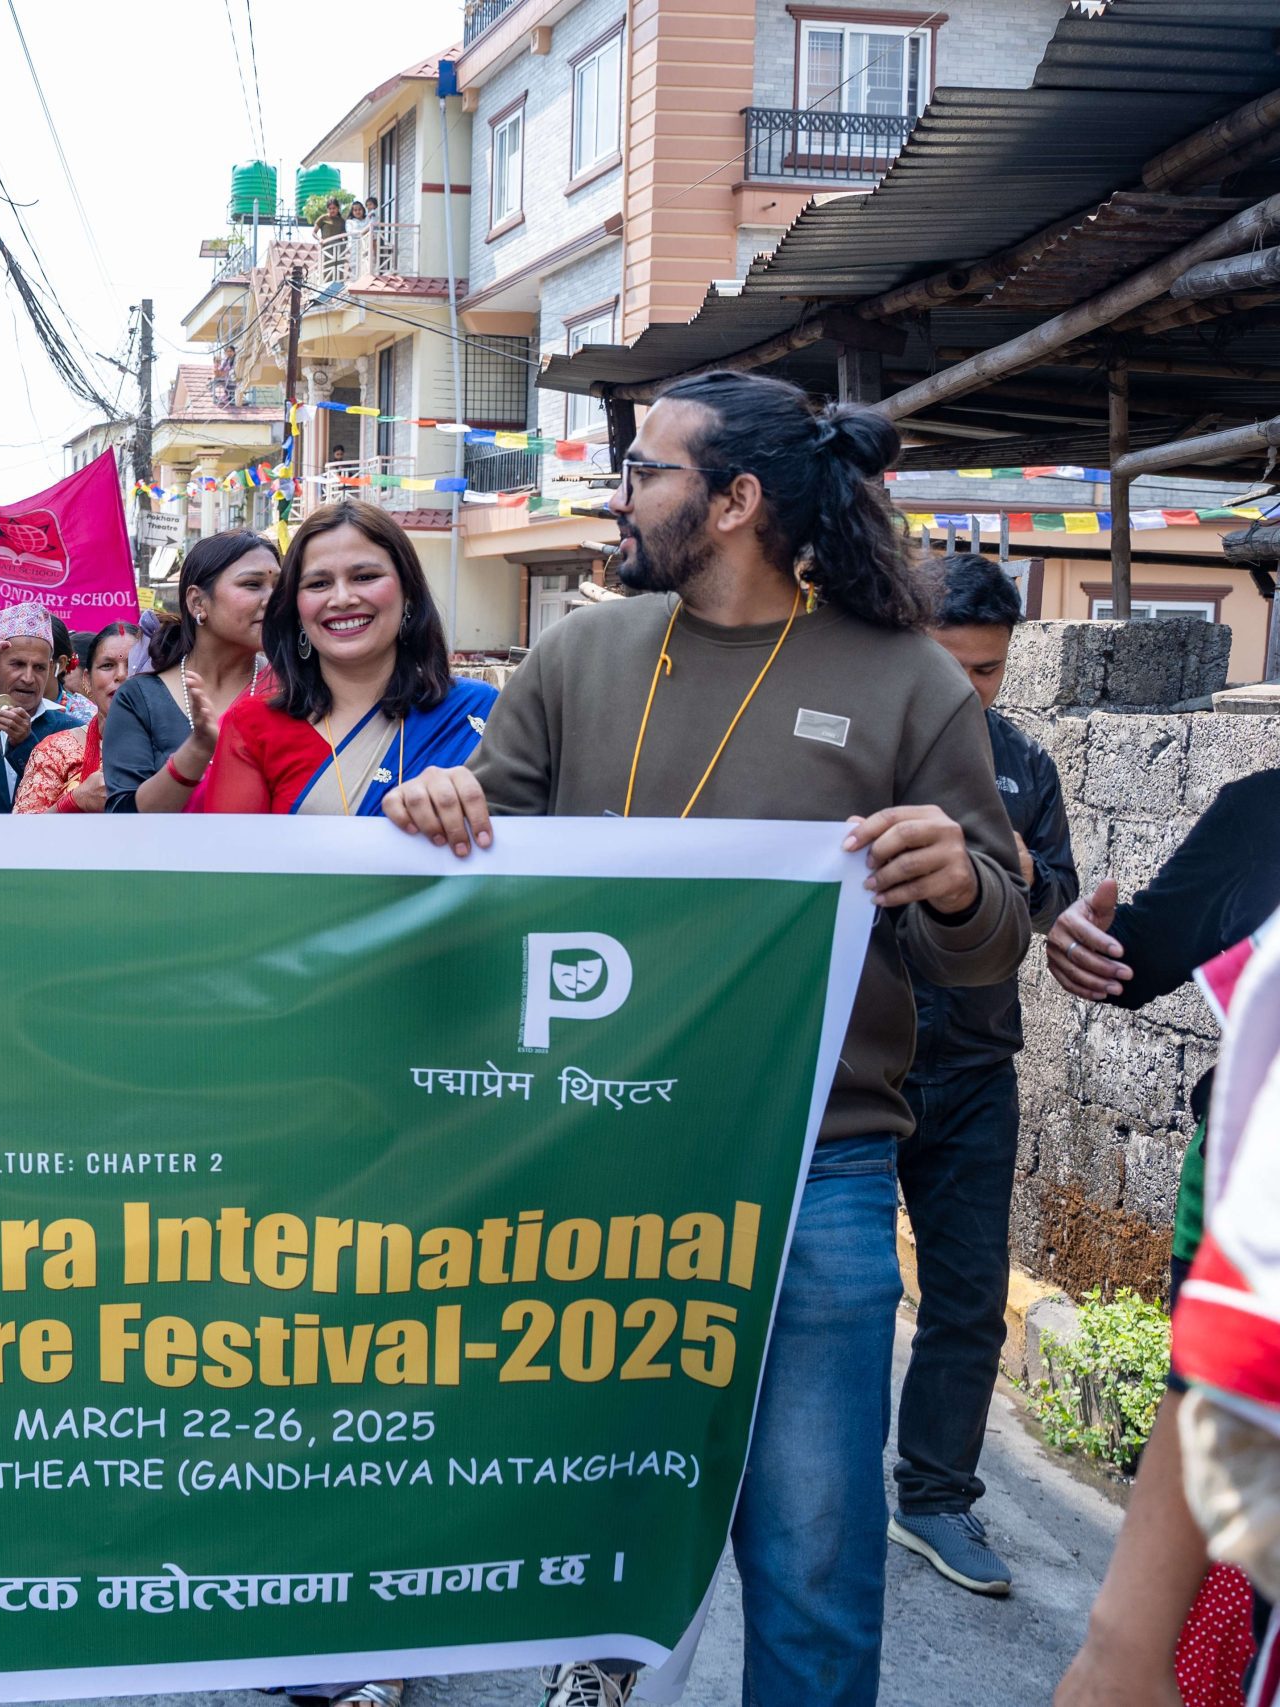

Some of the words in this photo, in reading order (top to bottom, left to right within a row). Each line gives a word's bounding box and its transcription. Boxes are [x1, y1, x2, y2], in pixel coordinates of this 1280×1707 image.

[146, 513, 180, 522] Pokhara
[148, 522, 178, 531] Theatre
[70, 591, 137, 608] SCHOOL
[523, 931, 633, 1049] P
[410, 1060, 535, 1100] पद्माप्रेम
[557, 1066, 677, 1110] थिएटर
[86, 1152, 196, 1174] CHAPTER
[210, 1153, 222, 1172] 2
[123, 1201, 761, 1294] International
[99, 1298, 737, 1388] Festival-2025
[14, 1407, 166, 1441] MARCH
[183, 1408, 316, 1447] 22-26,
[332, 1409, 435, 1442] 2025
[178, 1459, 433, 1496] (GANDHARVA
[448, 1450, 700, 1488] NATAKGHAR)
[97, 1563, 353, 1613] महोत्सवमा
[369, 1559, 525, 1601] स्वागत
[538, 1554, 591, 1585] छ
